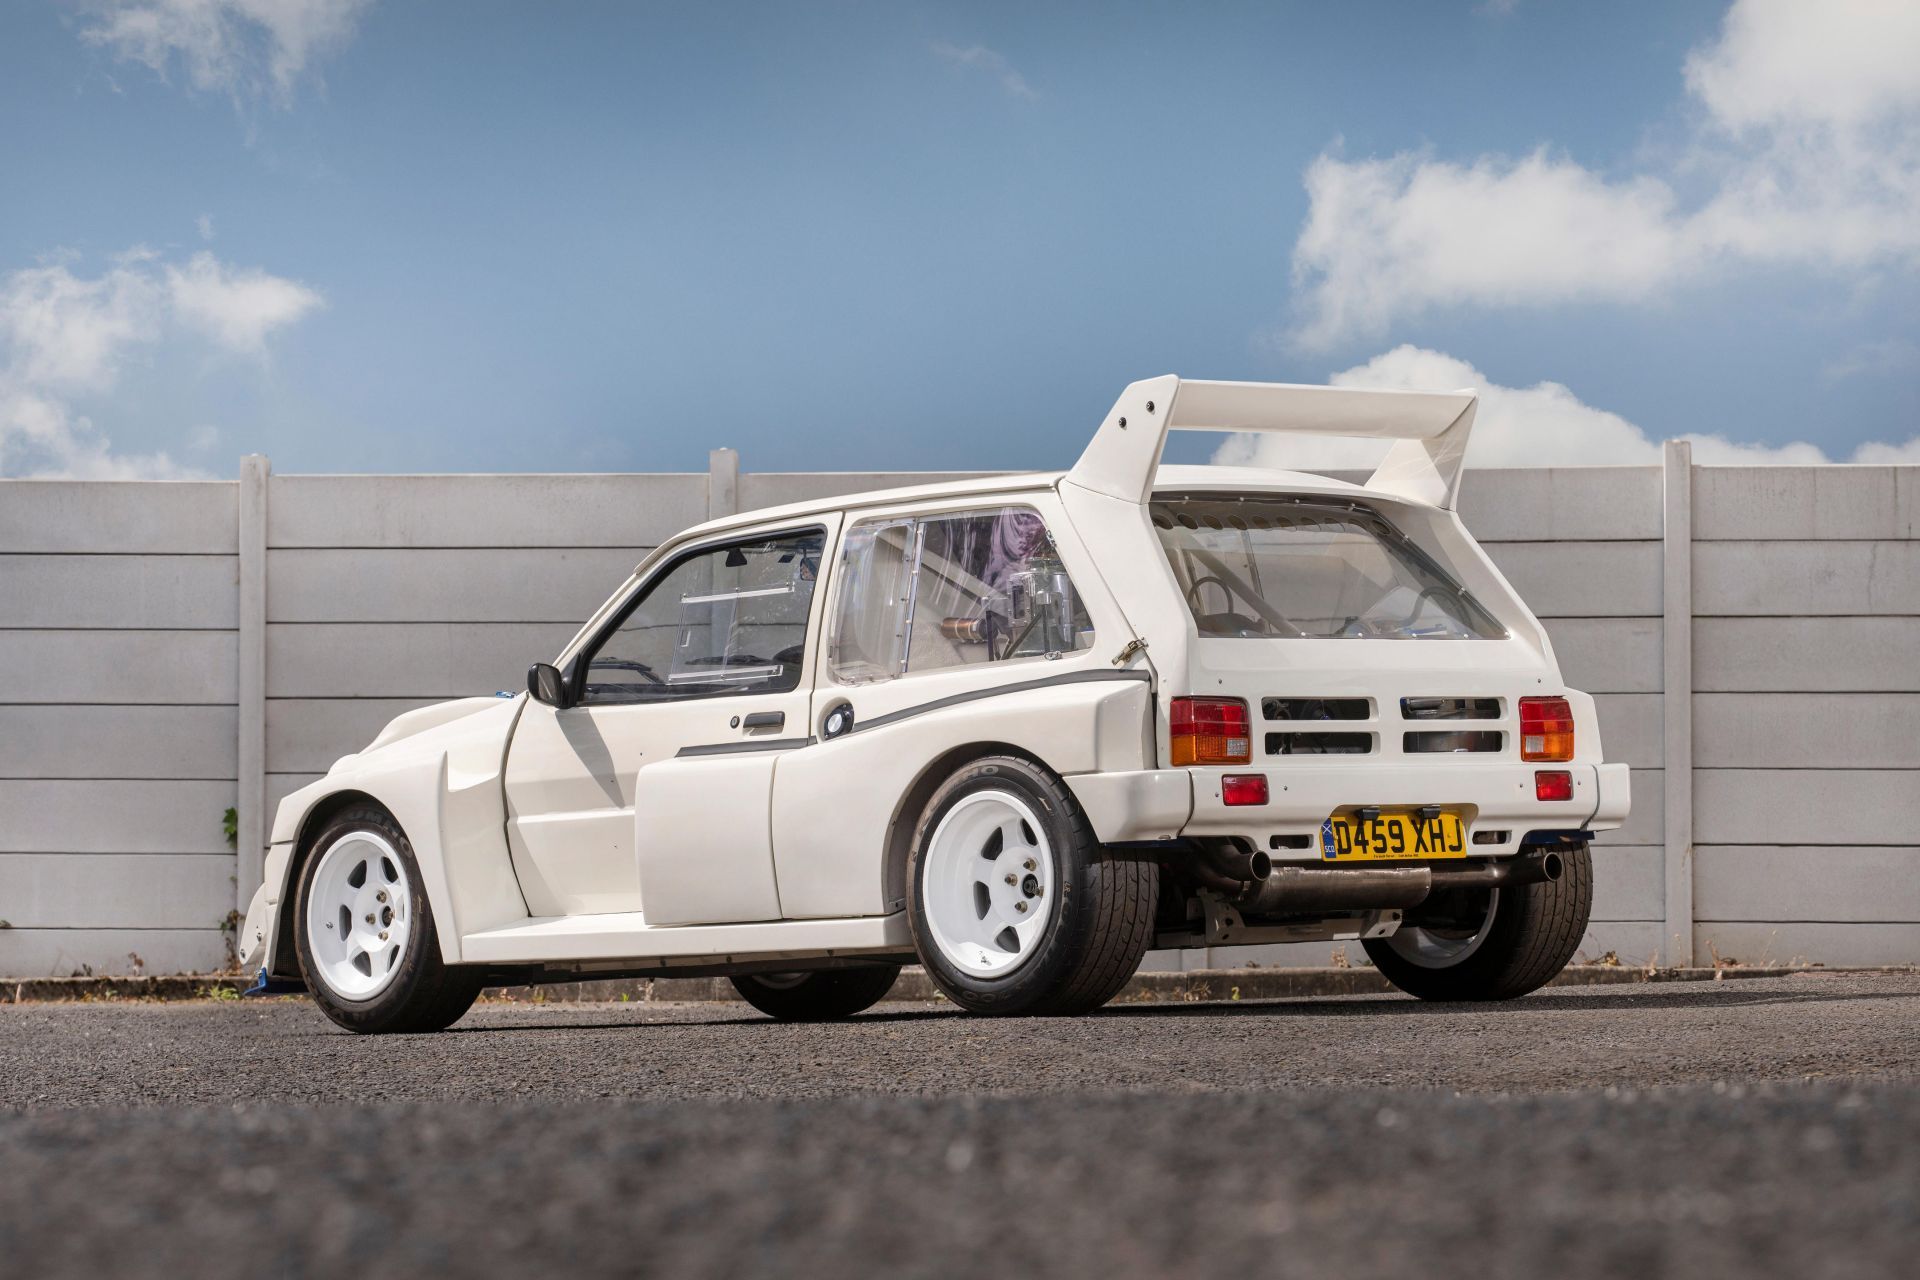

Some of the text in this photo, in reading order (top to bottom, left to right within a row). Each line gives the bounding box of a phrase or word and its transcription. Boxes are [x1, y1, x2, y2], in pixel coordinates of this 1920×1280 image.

[343, 809, 414, 859] UMHO
[1334, 818, 1463, 855] D459 XHJ
